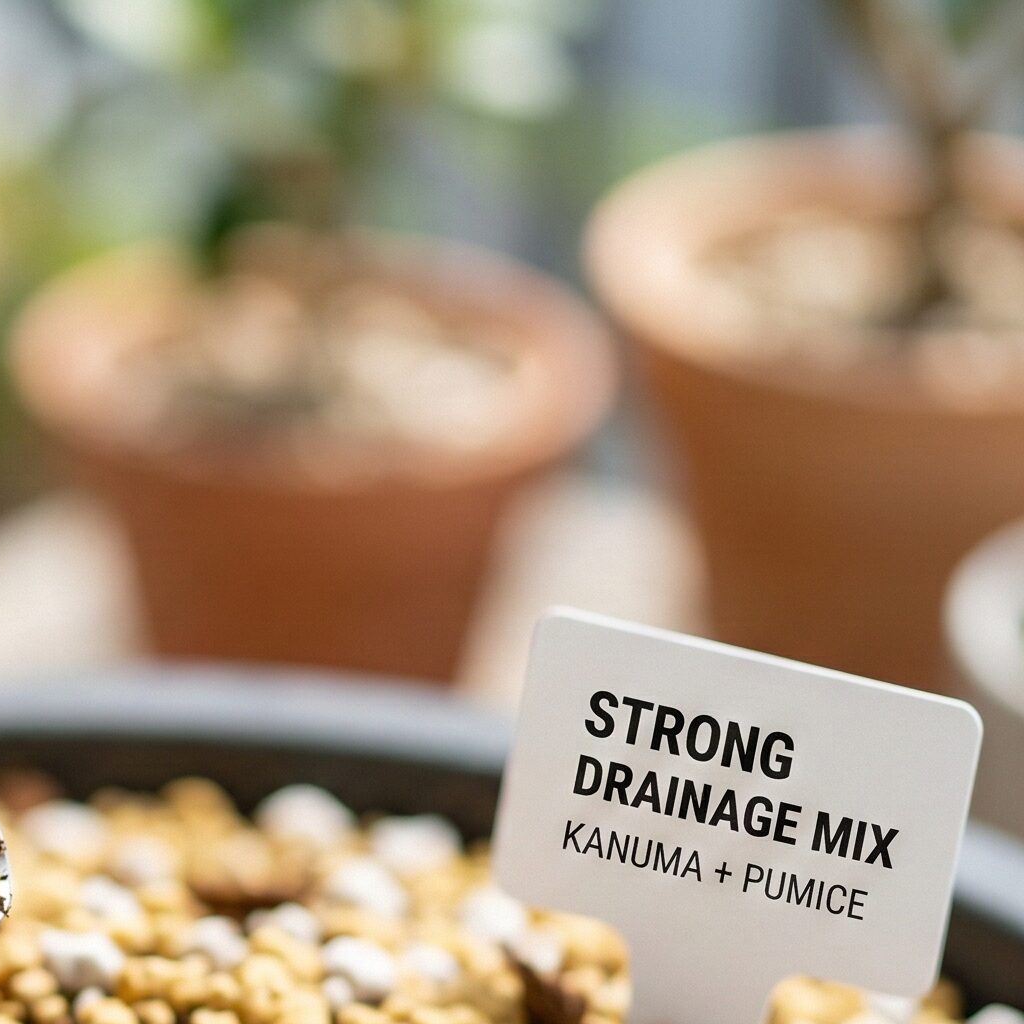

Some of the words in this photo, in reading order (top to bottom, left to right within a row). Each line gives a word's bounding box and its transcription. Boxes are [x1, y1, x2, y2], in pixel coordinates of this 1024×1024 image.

[584, 690, 795, 780] STRONG
[572, 753, 803, 846] DRAINAGE
[811, 810, 900, 870] MIX
[562, 819, 702, 883] KANUMA
[714, 861, 733, 884] +
[742, 862, 869, 921] PUMICE
